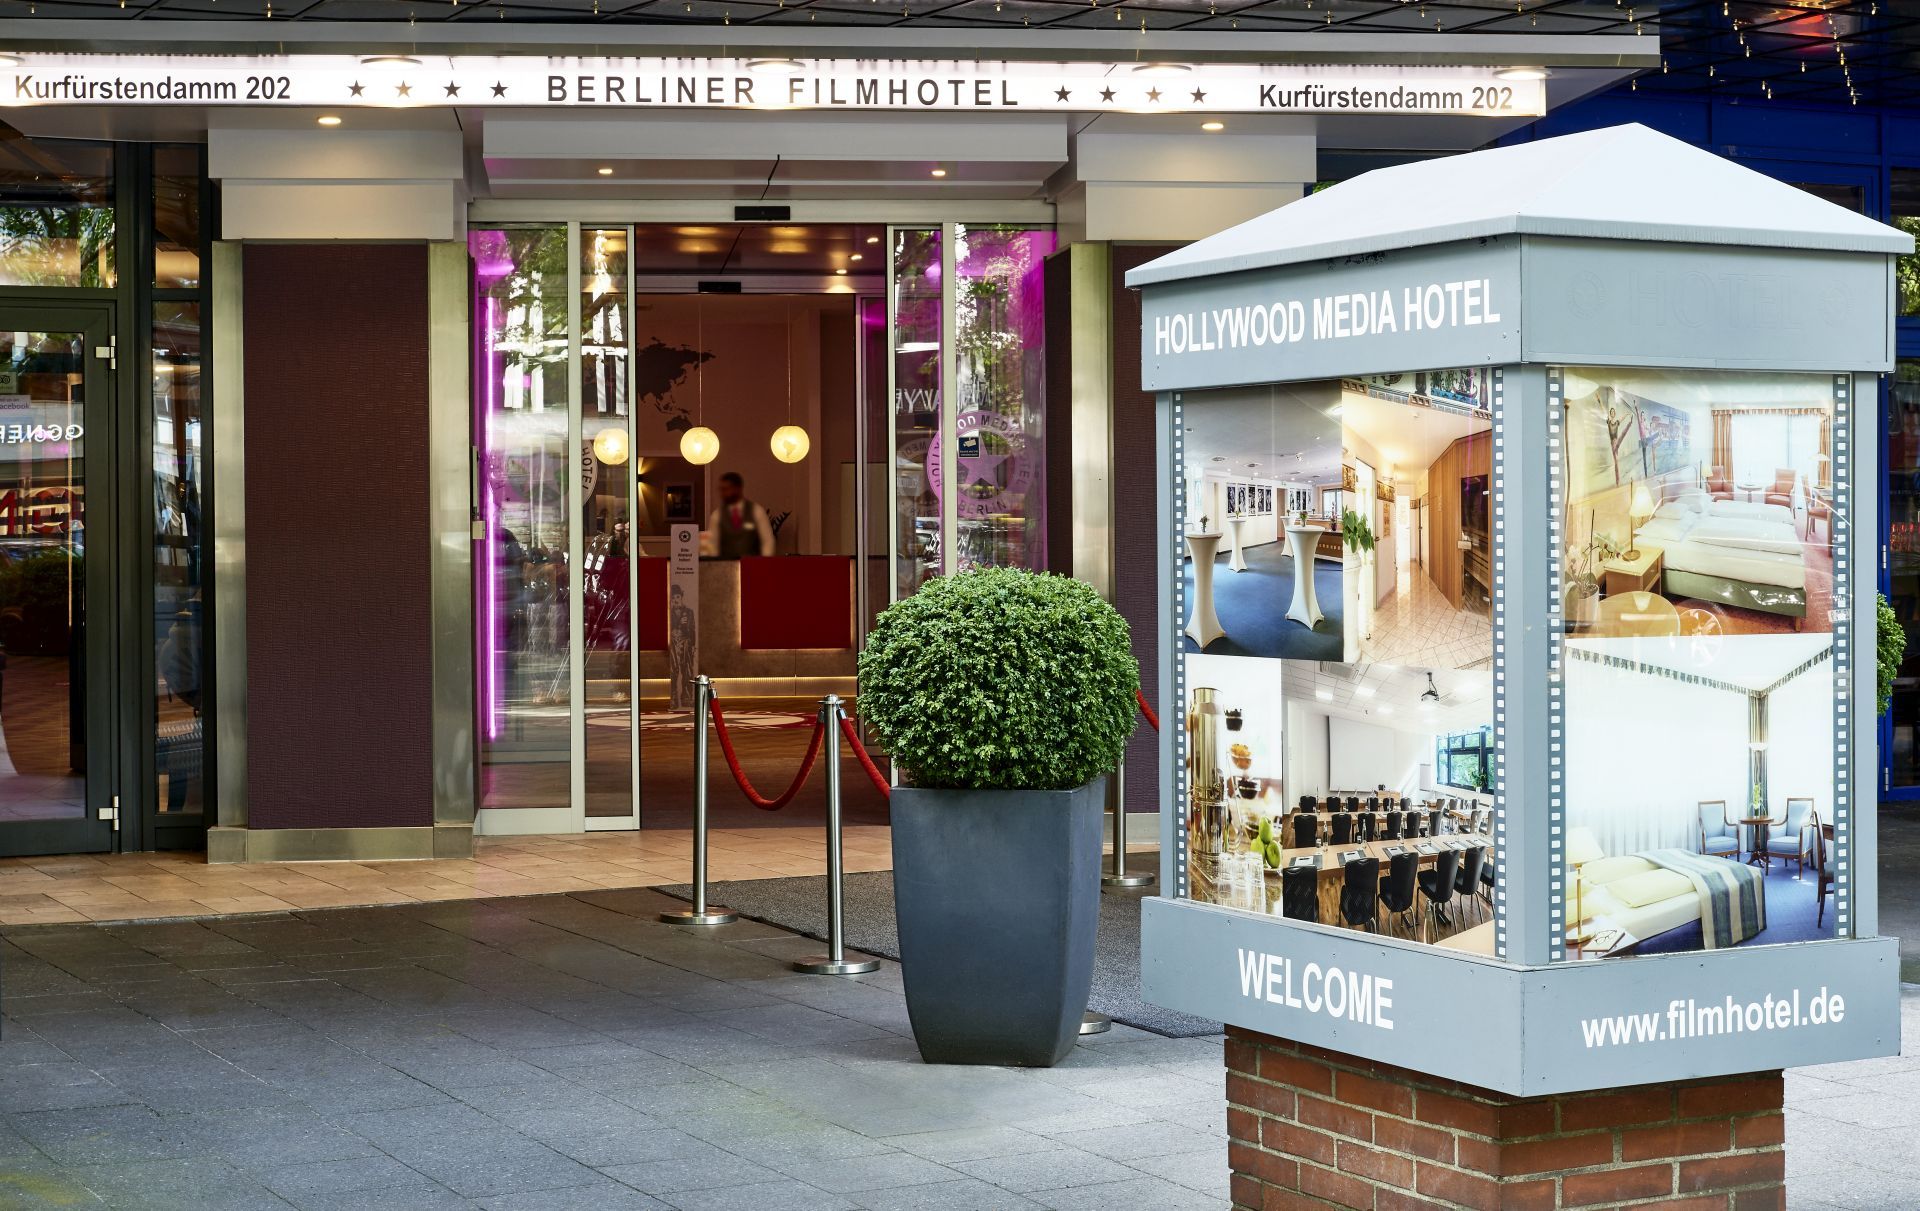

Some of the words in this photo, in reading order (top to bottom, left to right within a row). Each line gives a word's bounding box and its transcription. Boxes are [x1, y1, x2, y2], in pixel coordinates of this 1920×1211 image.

[15, 75, 237, 99] Kurfürstendamm
[246, 76, 291, 99] 202
[547, 75, 755, 103] BERLINER
[789, 77, 1018, 106] FILMHOTEL
[1259, 84, 1463, 110] Kurfürstendamm
[1471, 86, 1513, 110] 202
[1155, 300, 1305, 355] HOLLYWOOD
[1313, 290, 1397, 340] MEDIA
[1404, 278, 1501, 331] HOTEL
[1238, 948, 1394, 1030] WELCOME
[1581, 986, 1845, 1048] www.filmhotel.de
